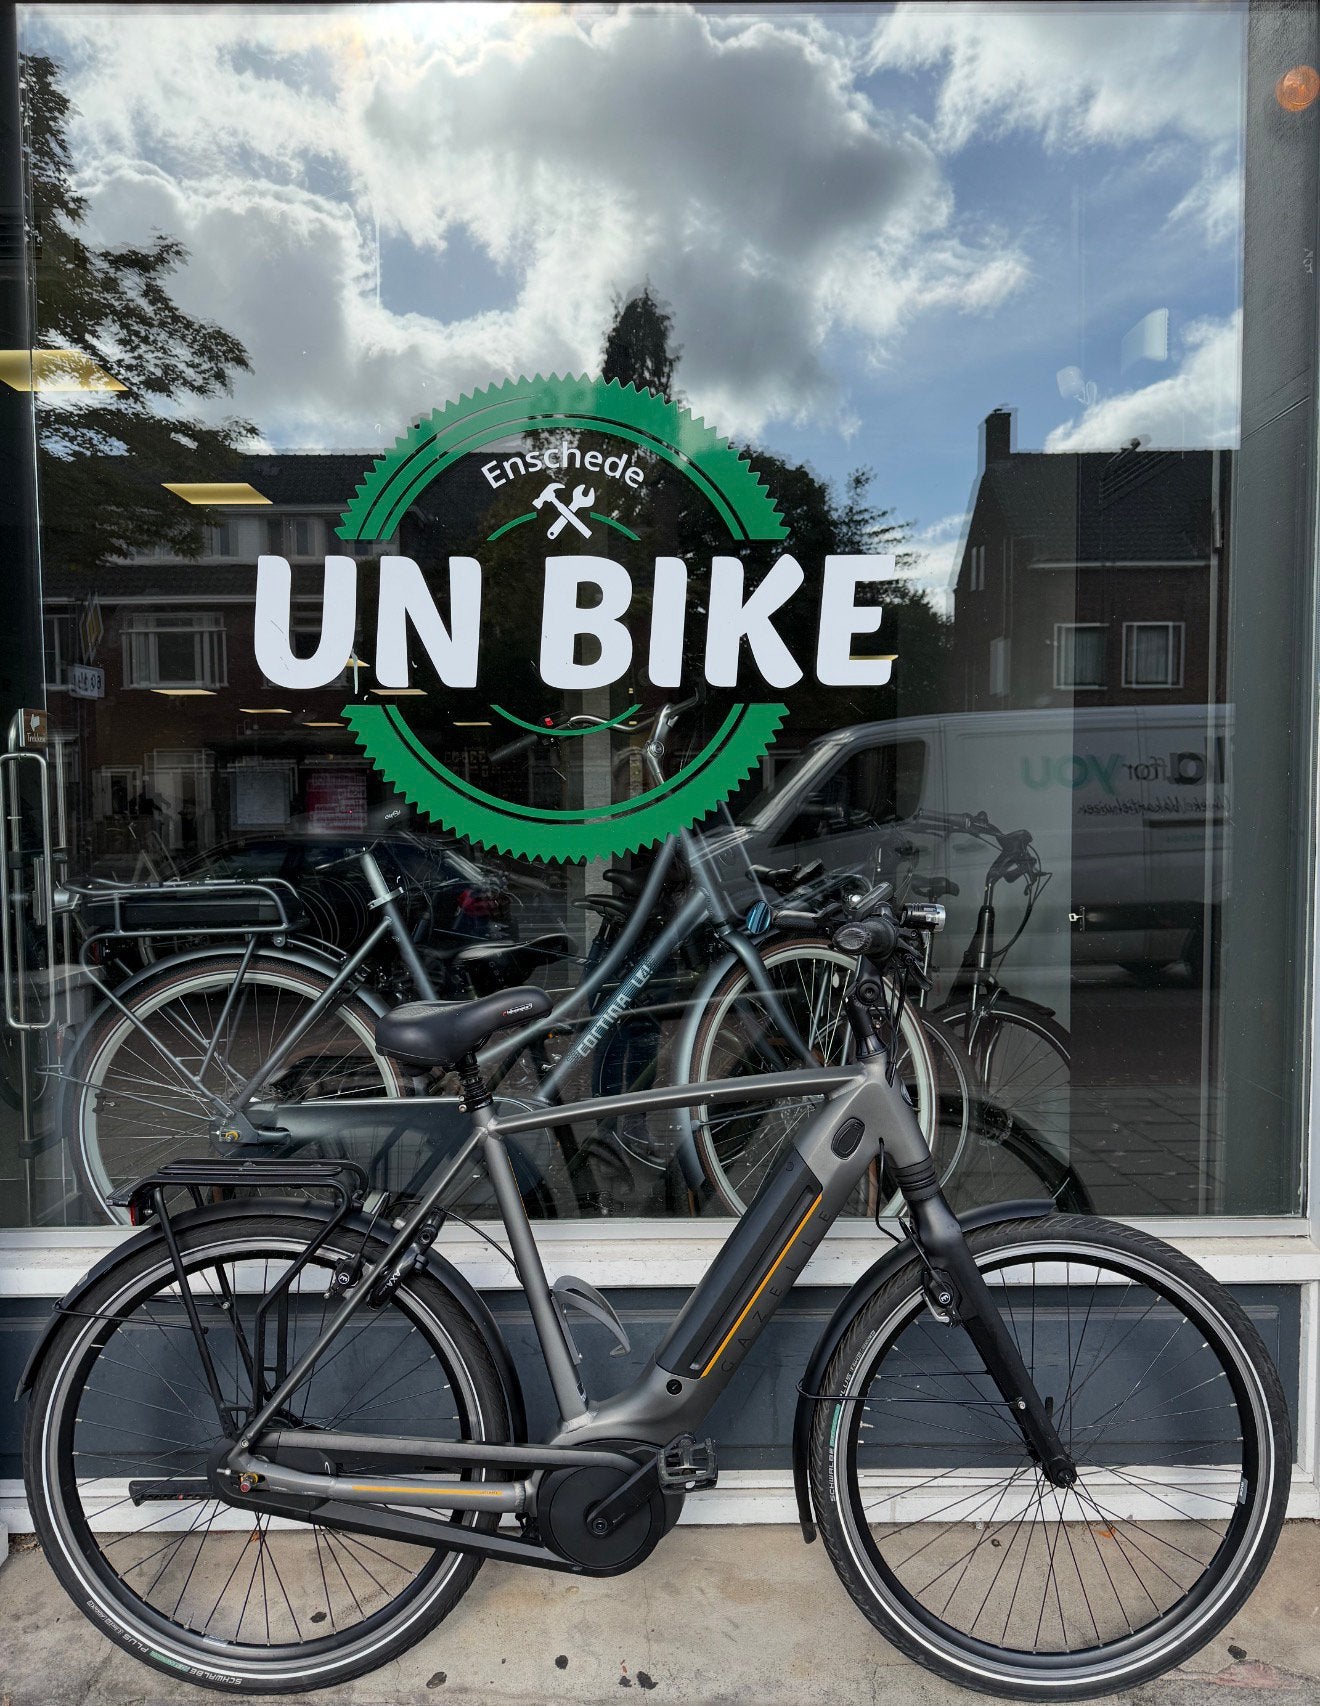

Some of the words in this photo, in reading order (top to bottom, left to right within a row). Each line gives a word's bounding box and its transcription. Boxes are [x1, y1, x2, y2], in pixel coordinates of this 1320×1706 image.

[482, 441, 645, 490] Enschede
[253, 555, 482, 690] UN
[540, 553, 896, 690] BIKE
[721, 1211, 831, 1373] GAZELLE
[122, 1633, 149, 1653] PLUS
[189, 1667, 243, 1685] SCHWALBE
